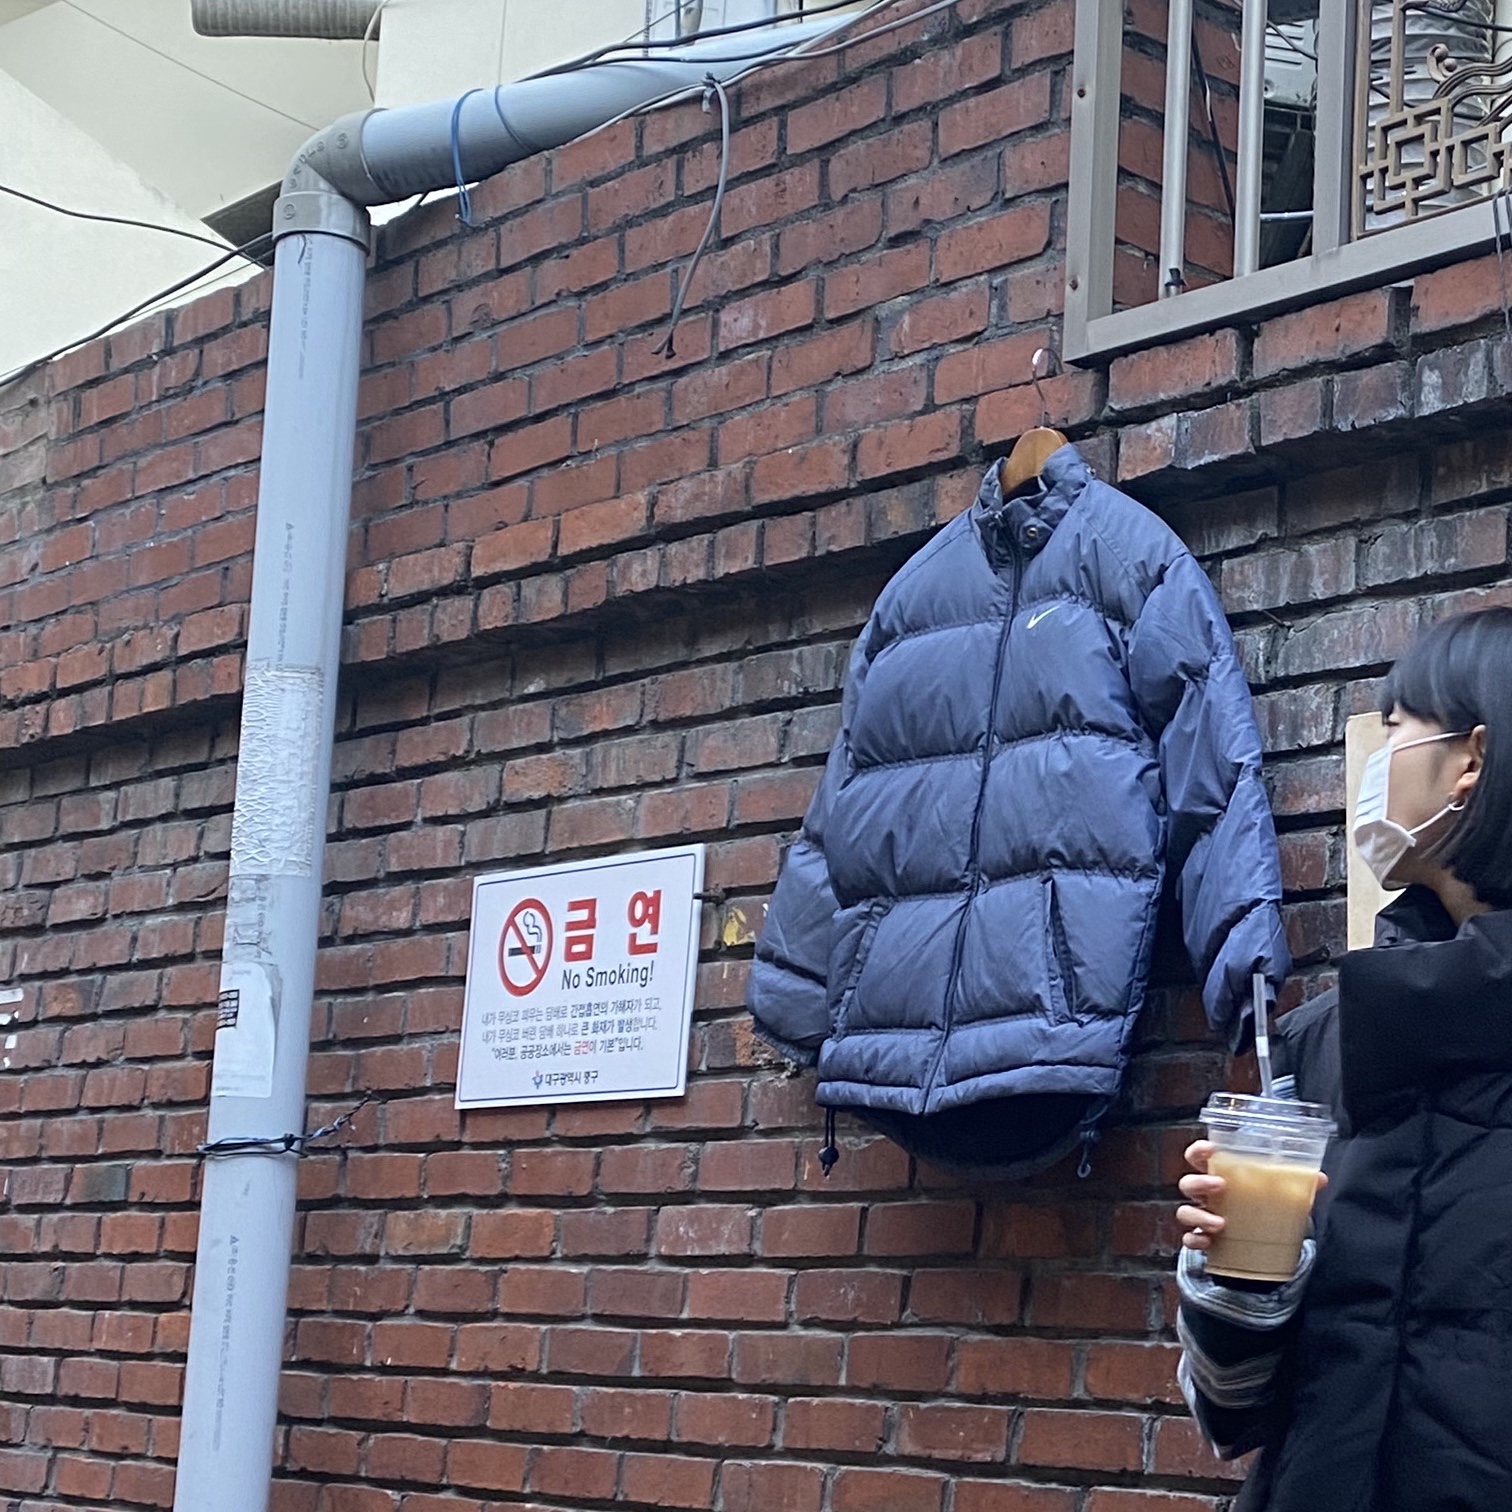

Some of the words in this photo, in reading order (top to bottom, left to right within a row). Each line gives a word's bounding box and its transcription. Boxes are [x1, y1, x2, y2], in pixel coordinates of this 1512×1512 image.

[564, 898, 597, 963] 금
[627, 889, 662, 956] 연
[561, 968, 581, 990] No
[585, 960, 654, 988] Smoking!
[581, 1021, 589, 1036] 큰
[545, 1070, 582, 1085] 대구광역시
